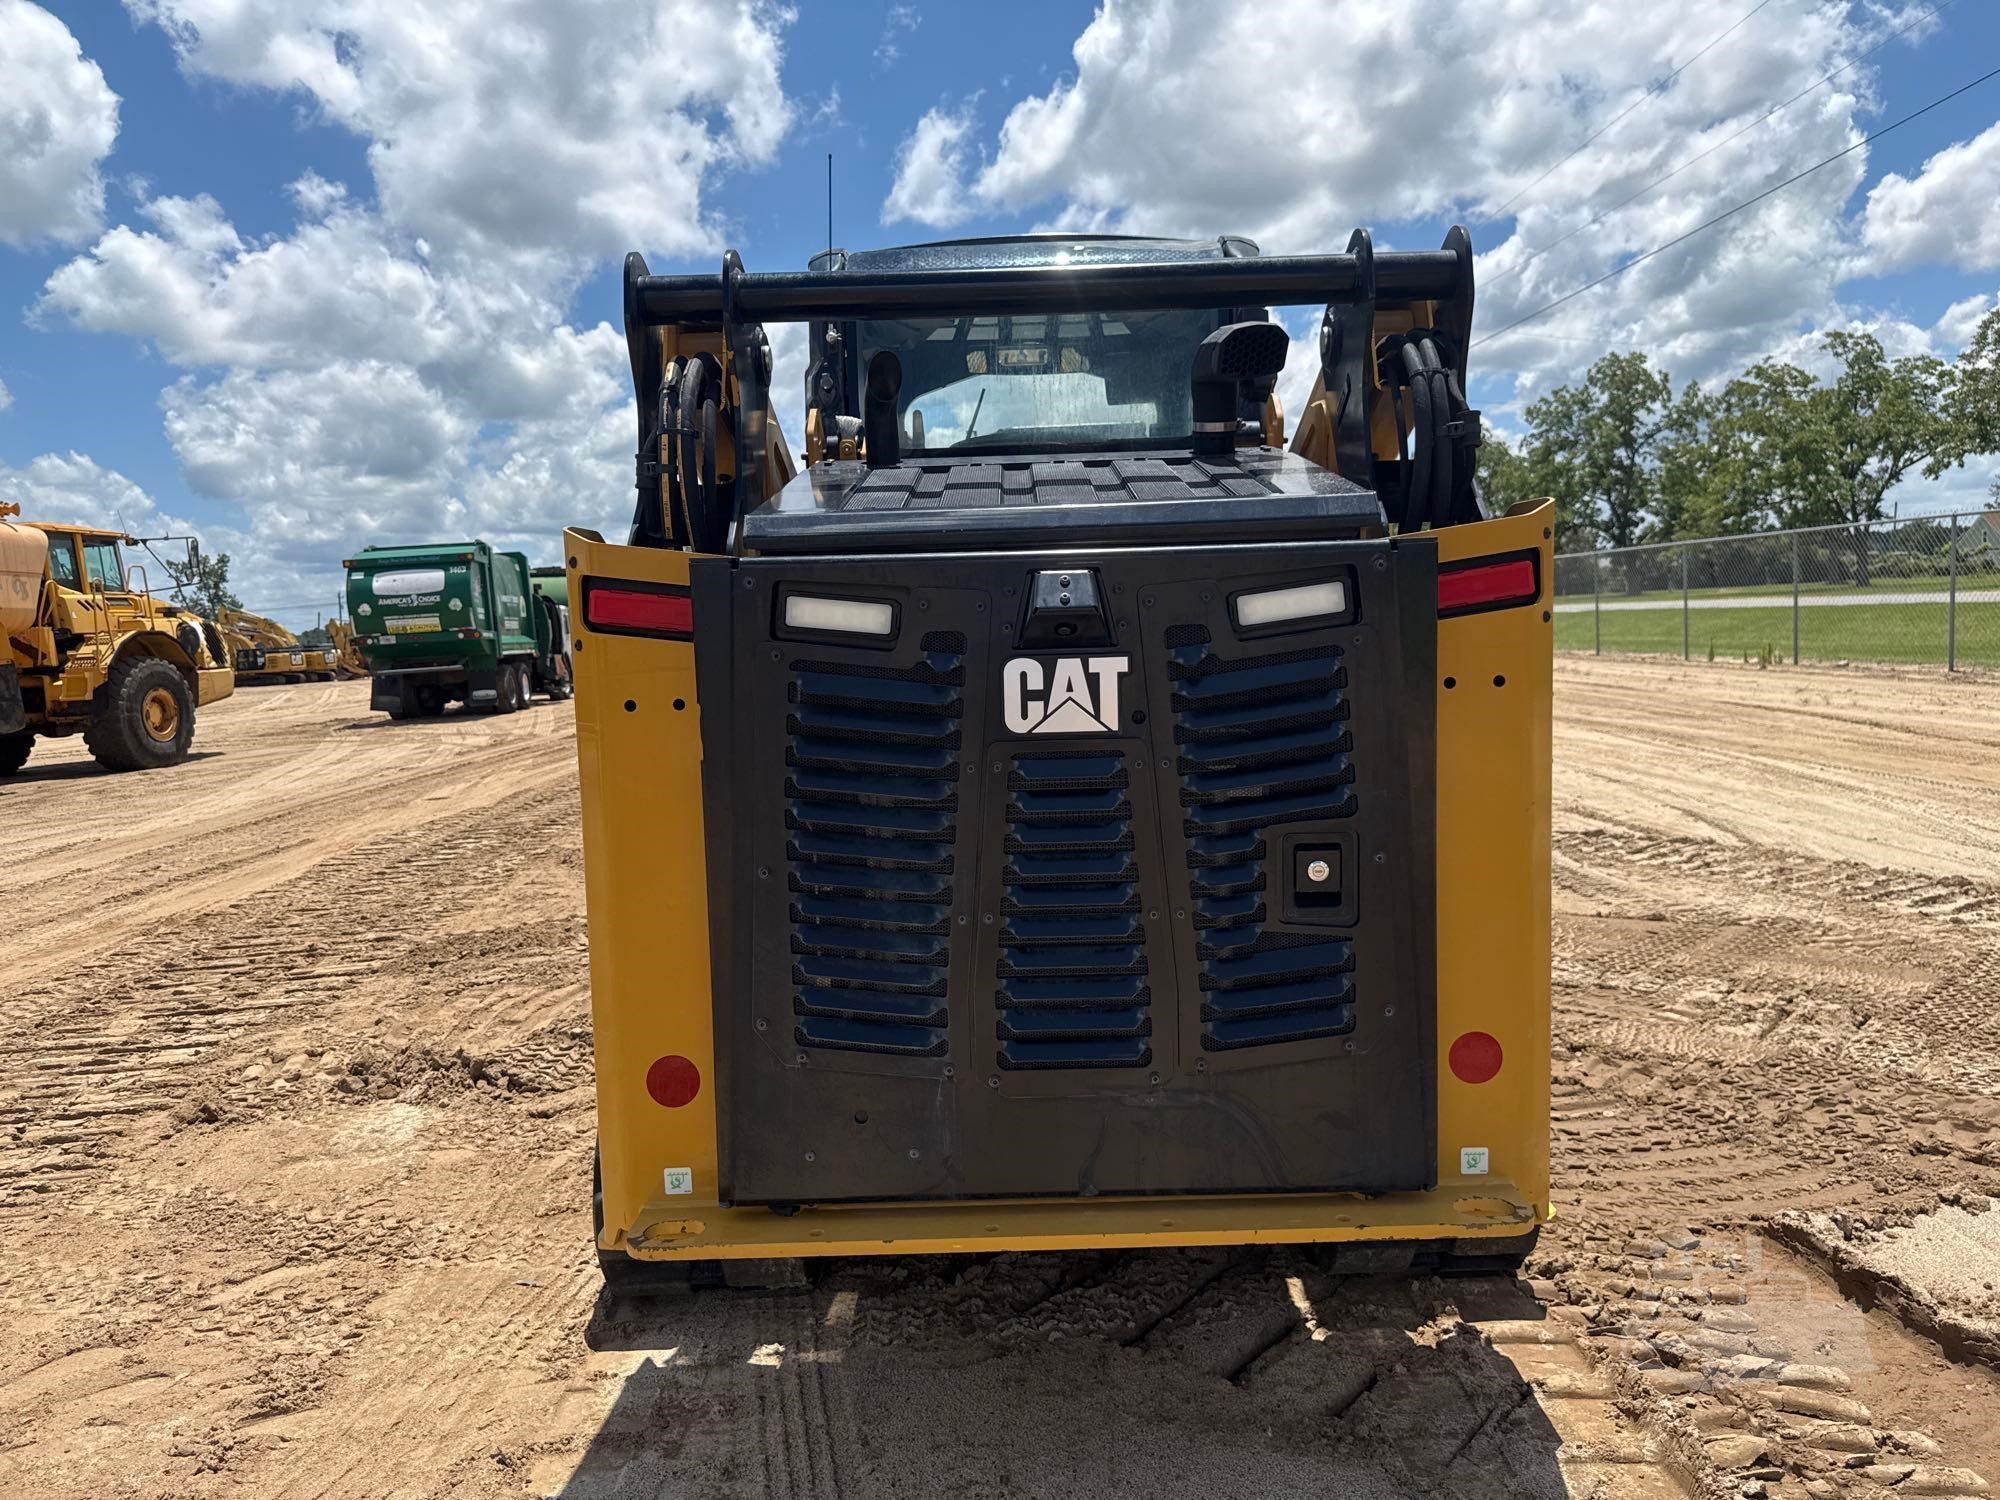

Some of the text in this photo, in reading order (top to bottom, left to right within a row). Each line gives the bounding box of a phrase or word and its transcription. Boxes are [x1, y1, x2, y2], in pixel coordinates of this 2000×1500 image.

[378, 597, 412, 606] AMERICA'S
[418, 595, 441, 603] CHOICE
[1003, 656, 1129, 734] CAT
